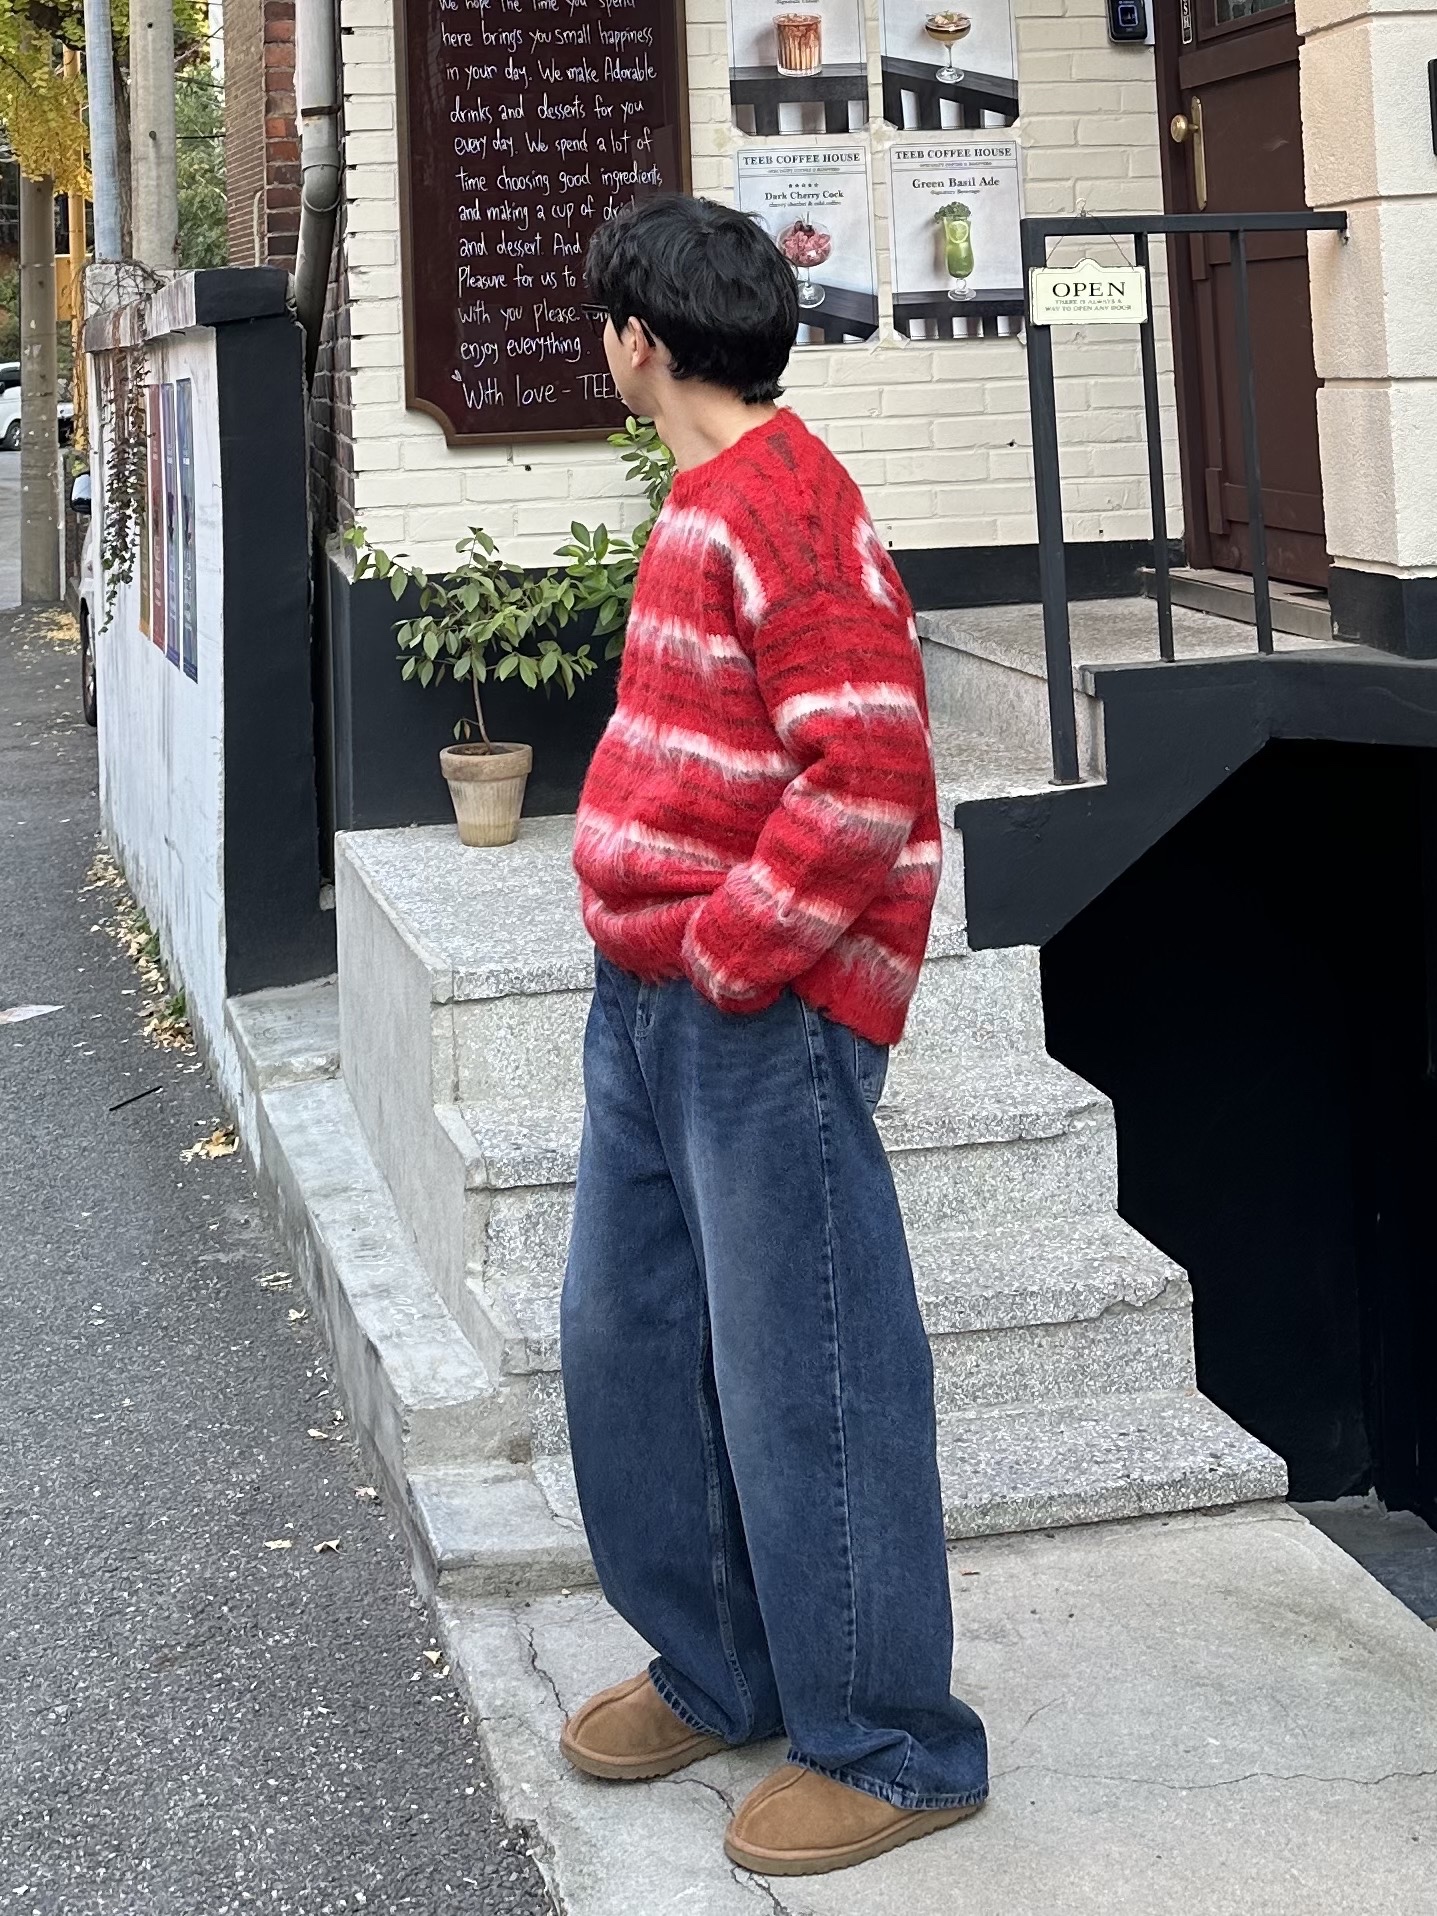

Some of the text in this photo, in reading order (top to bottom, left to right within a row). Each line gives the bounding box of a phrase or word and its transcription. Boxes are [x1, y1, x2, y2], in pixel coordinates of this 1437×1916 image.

[441, 22, 473, 47] here
[481, 20, 523, 53] brings
[529, 29, 552, 54] you
[598, 20, 653, 52] happiness
[445, 52, 657, 91] in your day. We make Adorable
[450, 92, 645, 125] drinks and desserts for you
[454, 127, 654, 161] every day. We spend a lot of
[895, 147, 1012, 160] TEEB COFFEE HOUSE
[743, 153, 861, 165] TEEB COFFEE HOUSE
[455, 160, 663, 196] time choosing good ingredients
[912, 176, 1000, 189] Green Basil Ade
[764, 192, 788, 201] Dark
[790, 191, 821, 200] Cherry
[458, 198, 482, 222] and
[486, 200, 529, 231] making
[536, 205, 546, 221] a
[551, 203, 574, 229] cup
[580, 195, 597, 218] of
[459, 232, 489, 257] and
[553, 232, 583, 257] And
[513, 263, 535, 288] for
[540, 272, 558, 289] us
[561, 265, 577, 288] to
[1052, 282, 1126, 298] OPEN
[500, 306, 523, 332] you
[460, 342, 499, 368] enjoy
[516, 374, 558, 407] love
